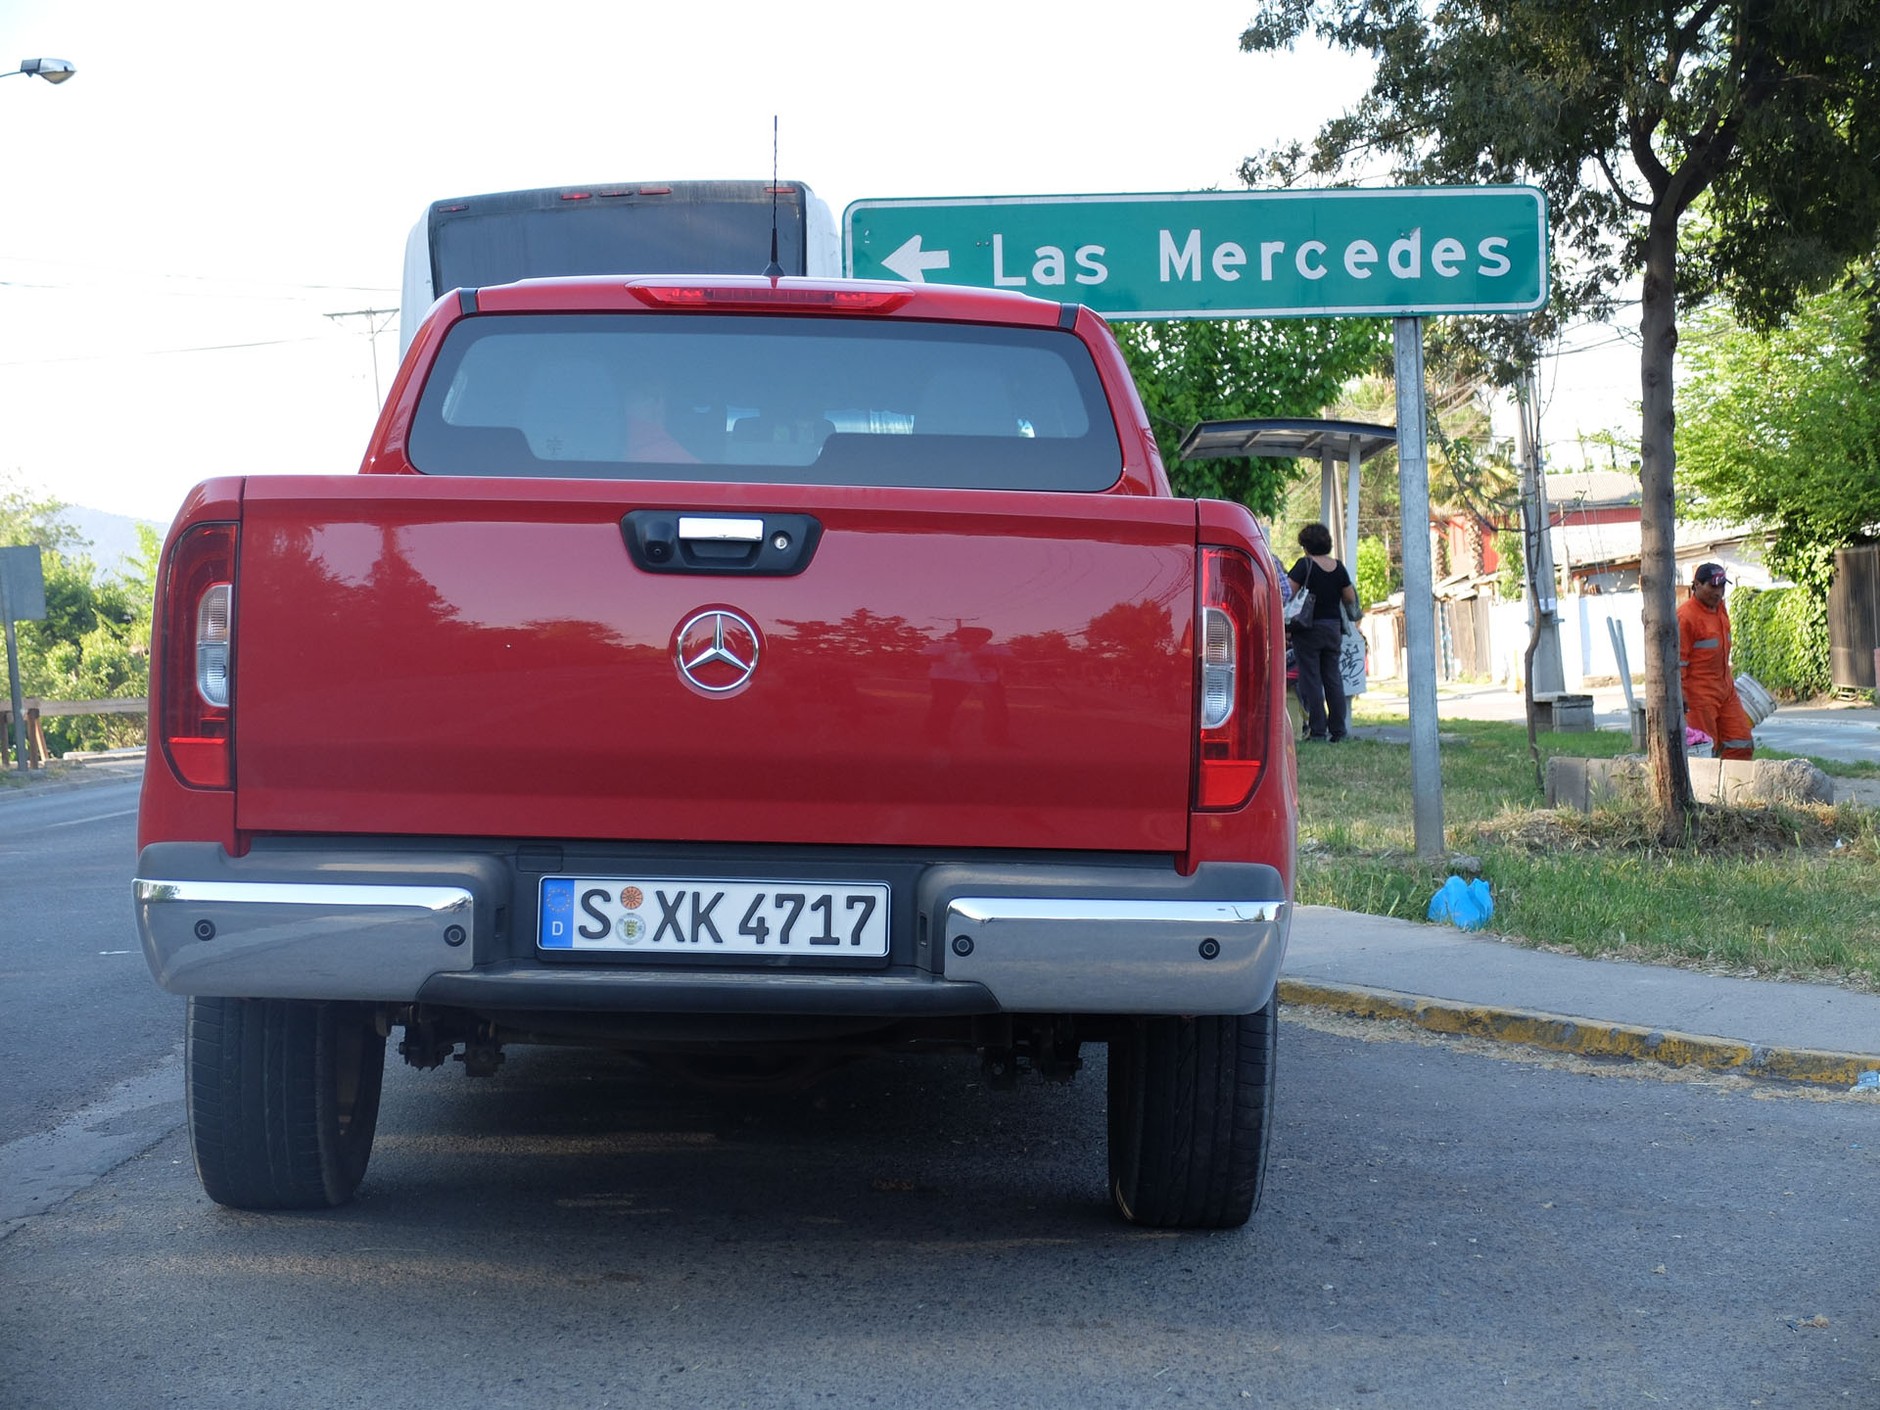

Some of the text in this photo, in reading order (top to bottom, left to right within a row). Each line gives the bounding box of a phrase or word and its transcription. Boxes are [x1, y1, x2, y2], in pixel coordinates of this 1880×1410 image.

[993, 226, 1511, 286] Las Mercedes
[552, 921, 563, 936] D
[578, 888, 877, 946] S XK 4717
